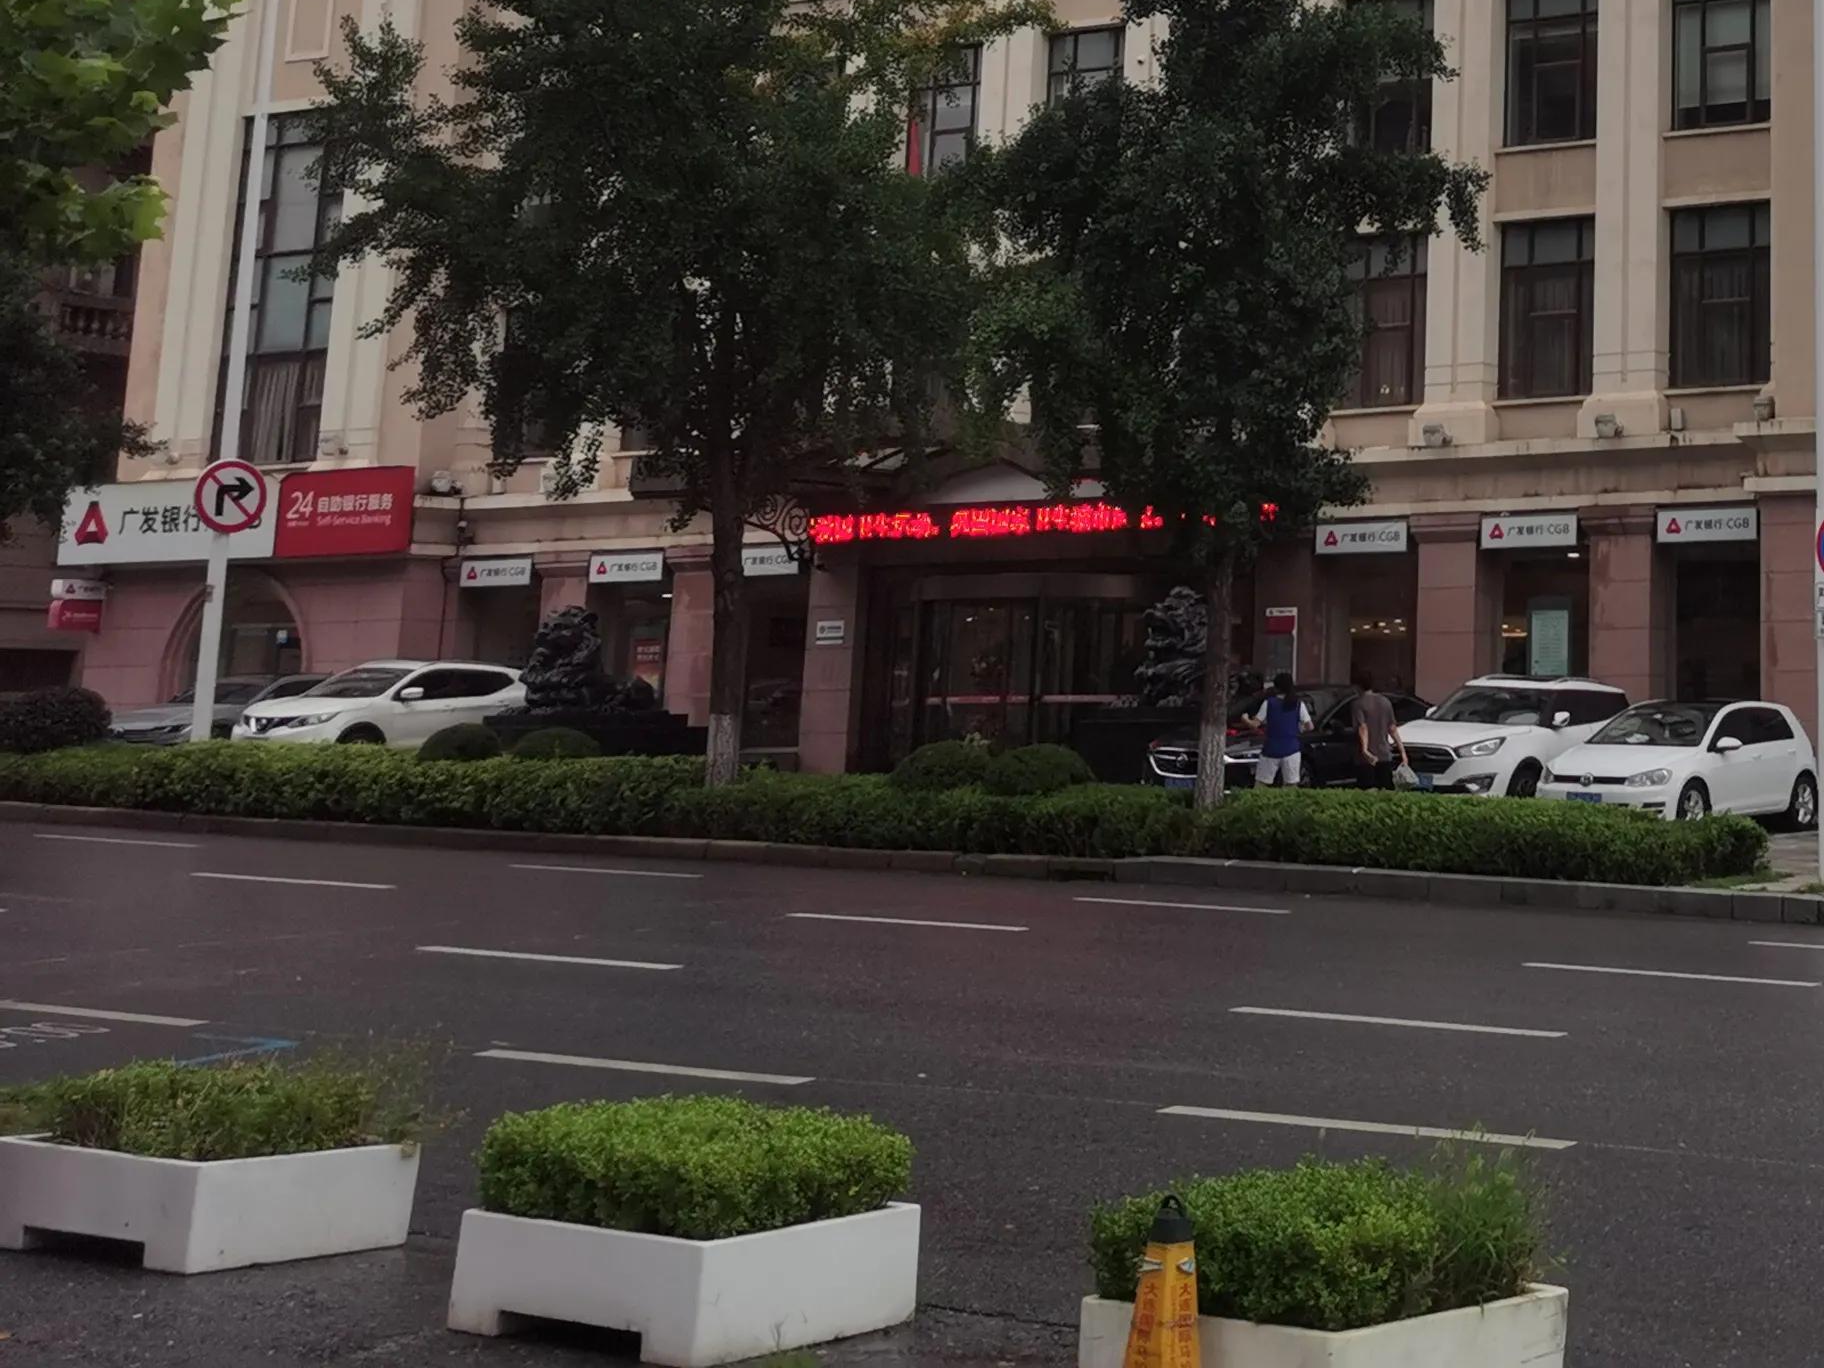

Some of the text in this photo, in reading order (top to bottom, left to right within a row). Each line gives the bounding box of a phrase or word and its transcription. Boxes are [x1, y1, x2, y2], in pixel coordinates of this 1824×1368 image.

[285, 491, 315, 519] 24
[118, 505, 201, 535] 广发银行
